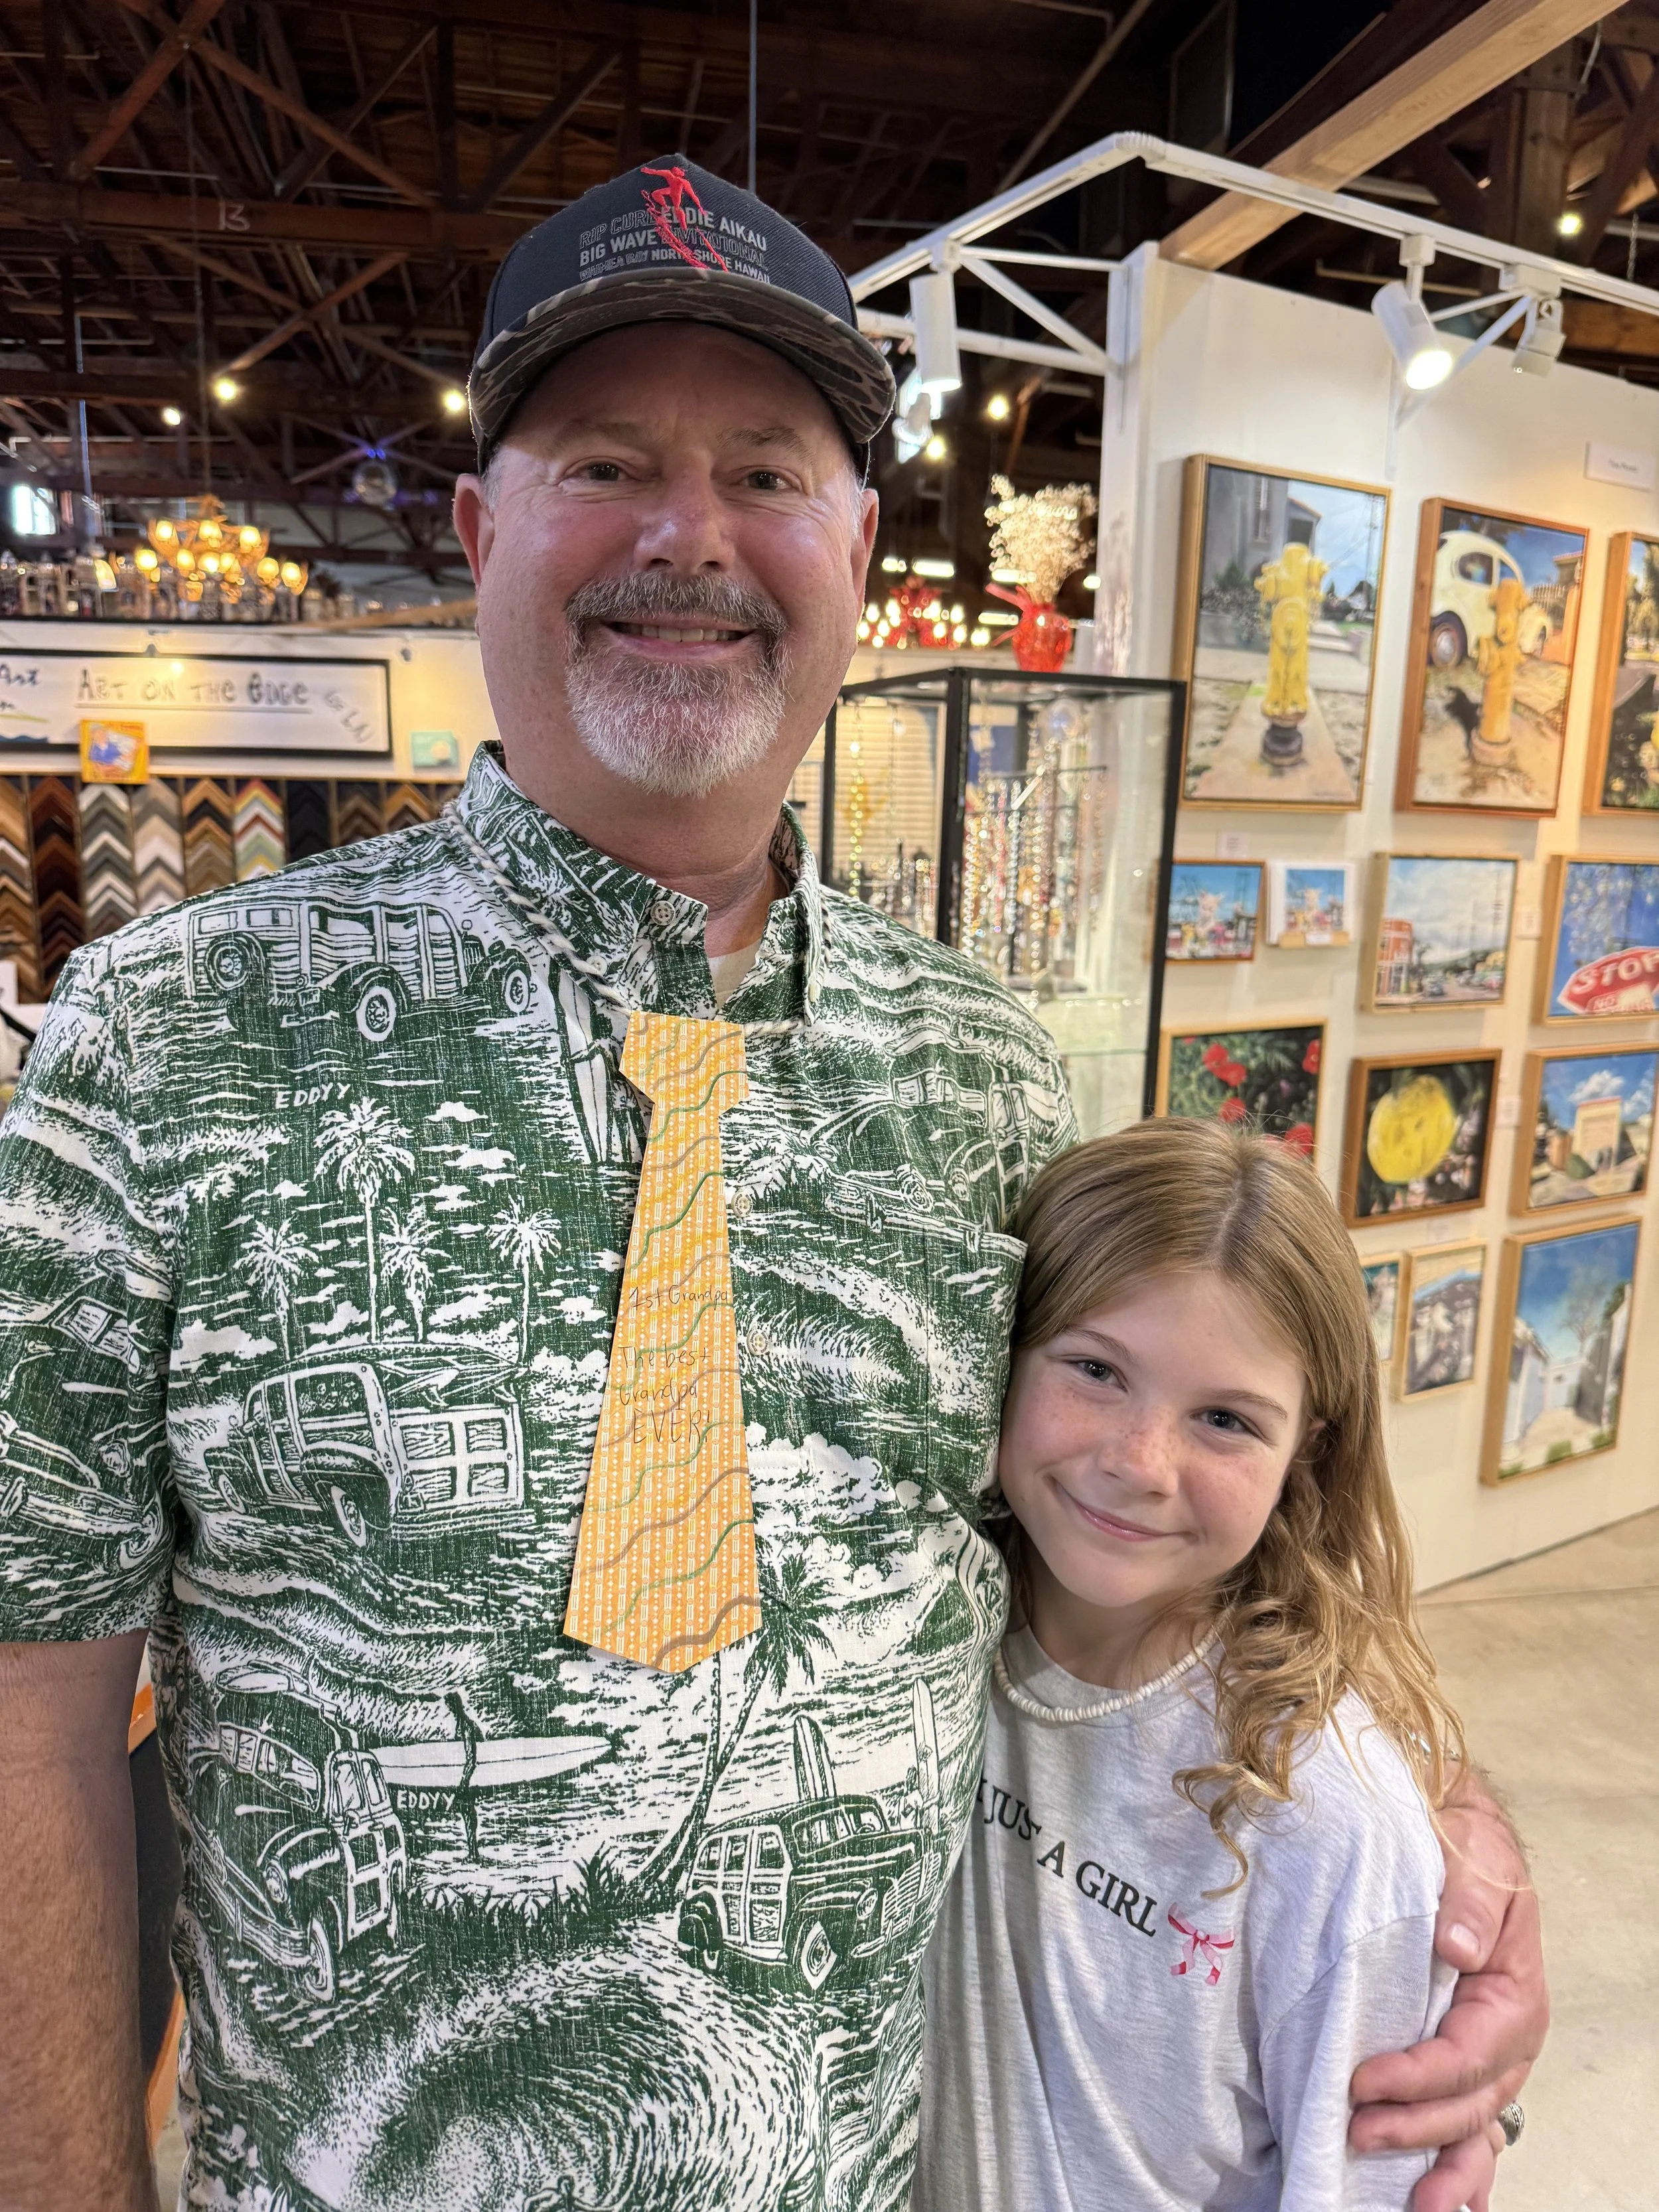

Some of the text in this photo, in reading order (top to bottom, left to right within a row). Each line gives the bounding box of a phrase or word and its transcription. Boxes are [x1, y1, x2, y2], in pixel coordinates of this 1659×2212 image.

[219, 198, 250, 232] 13
[579, 223, 607, 250] RIP
[611, 210, 656, 234] CURL
[719, 216, 767, 252] AIKAU
[579, 243, 606, 267] BIG
[611, 229, 658, 253] WAVE
[735, 259, 770, 284] HAWAII
[628, 1284, 728, 1311] 1st Grandpa
[618, 1343, 712, 1369] The best
[619, 1377, 697, 1410] Grandpa
[633, 1408, 710, 1444] EVER!
[1037, 1840, 1065, 1878] A
[1076, 1860, 1157, 1938] GIRL
